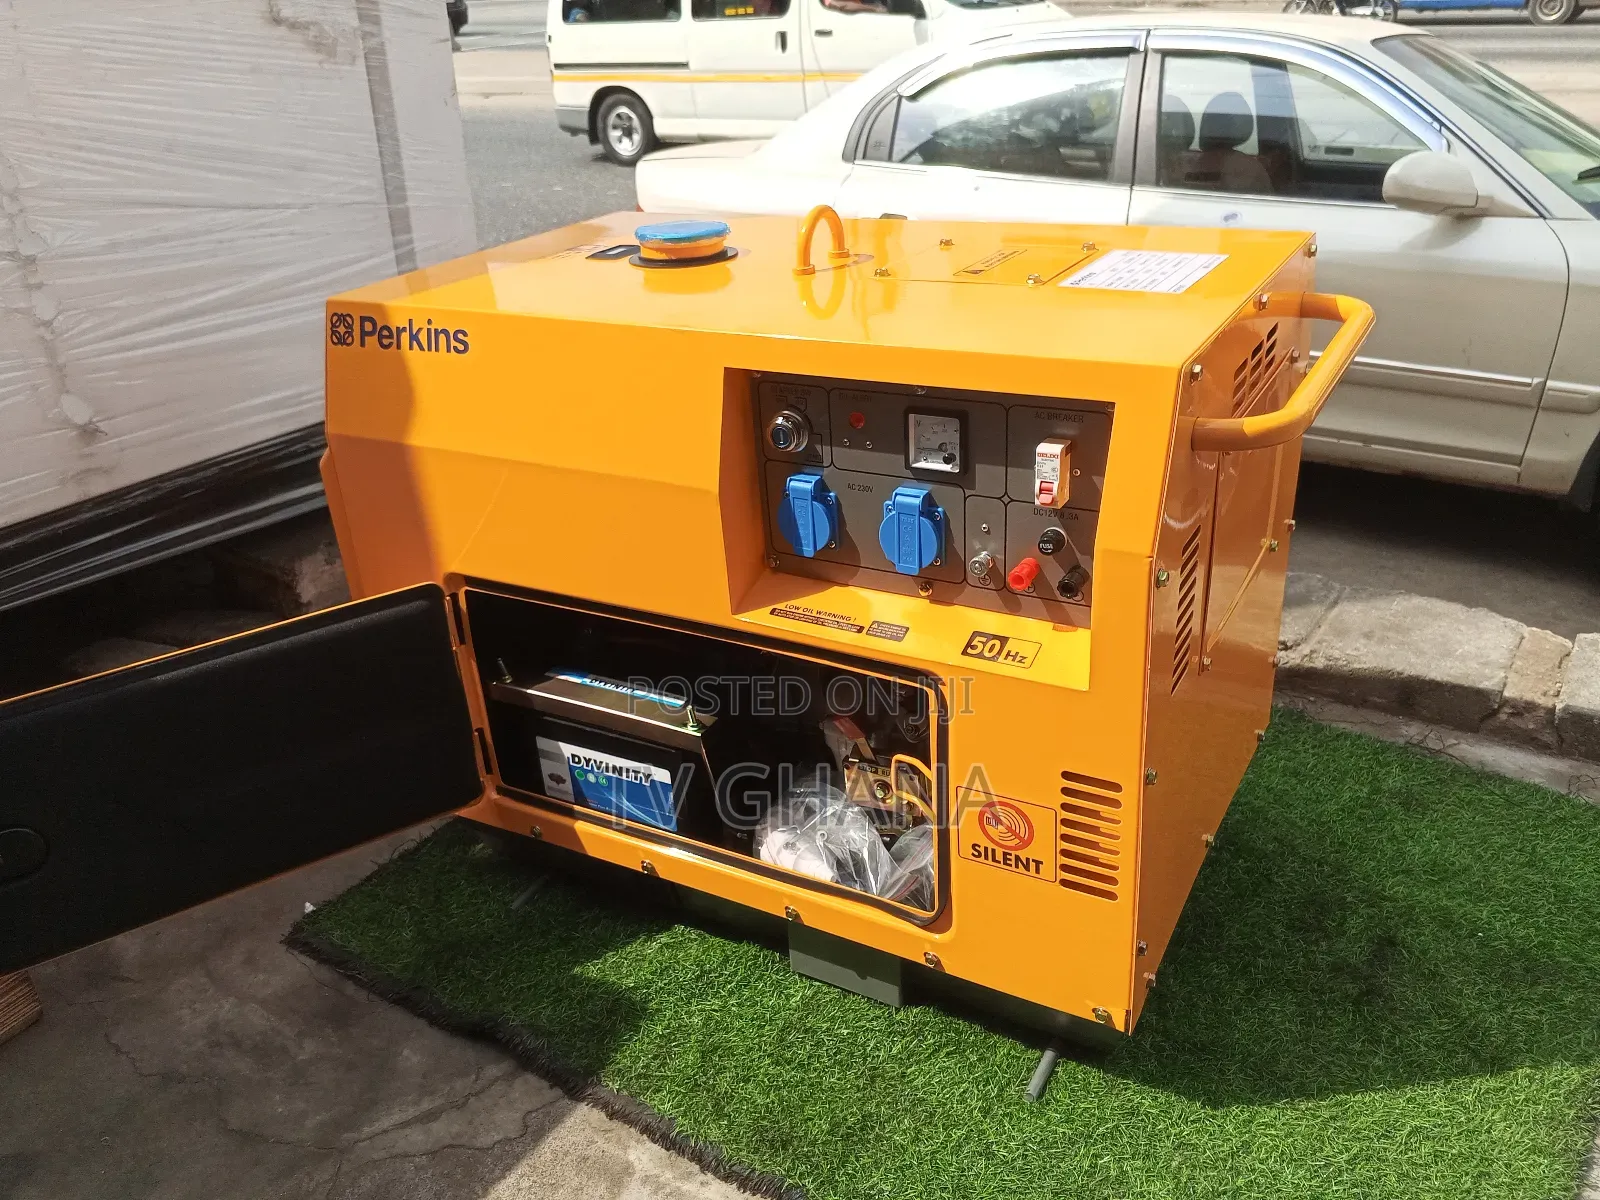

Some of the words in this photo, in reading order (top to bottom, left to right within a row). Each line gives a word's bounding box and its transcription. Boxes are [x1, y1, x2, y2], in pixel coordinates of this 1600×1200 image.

[360, 315, 470, 355] Perkins
[1047, 412, 1084, 423] BREAKER
[847, 482, 857, 491] AC
[857, 484, 874, 493] 230V
[785, 603, 801, 613] LOW
[803, 607, 814, 616] OIL
[816, 610, 852, 623] WARNING
[966, 635, 1003, 658] 50
[1003, 649, 1029, 665] Hz
[570, 752, 653, 786] DYVINITY
[859, 763, 876, 773] STOP
[971, 843, 1044, 875] SILENT
